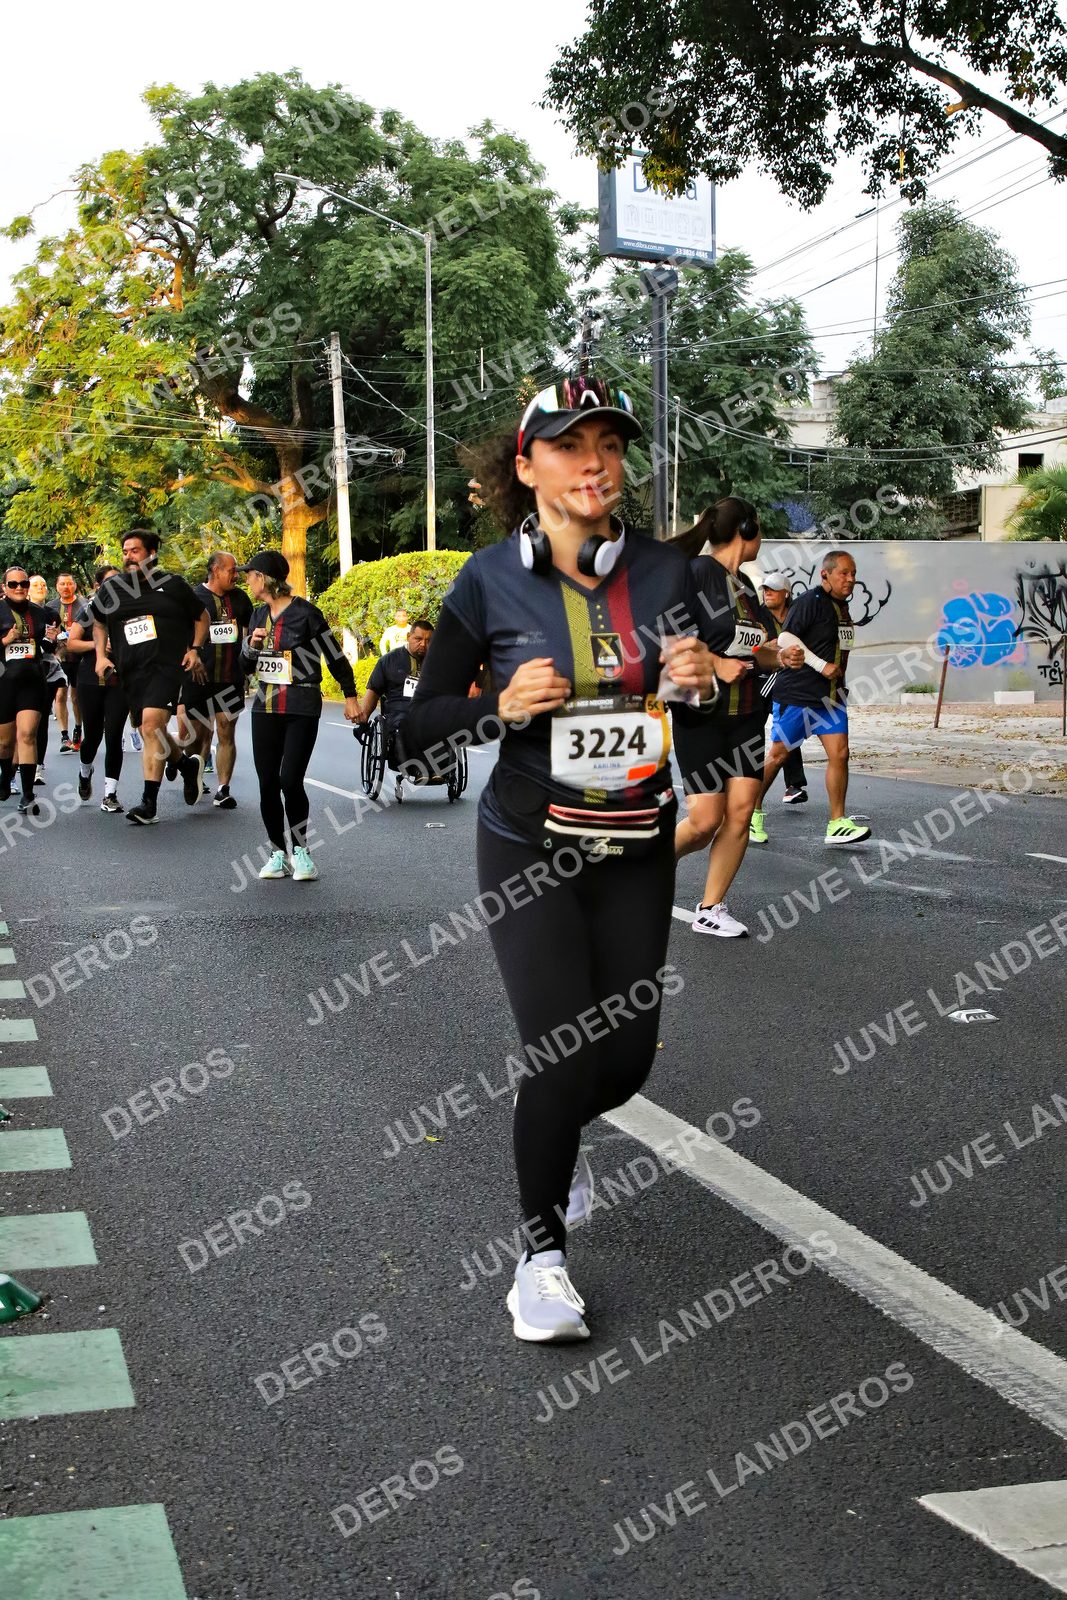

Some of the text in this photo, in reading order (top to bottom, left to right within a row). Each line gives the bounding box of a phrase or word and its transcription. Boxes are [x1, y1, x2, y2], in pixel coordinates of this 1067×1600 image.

[128, 623, 149, 637] 3256
[213, 626, 233, 636] 6949
[737, 631, 762, 648] 7089
[9, 646, 29, 655] 5993
[258, 660, 283, 672] 2299
[568, 725, 647, 760] 3224
